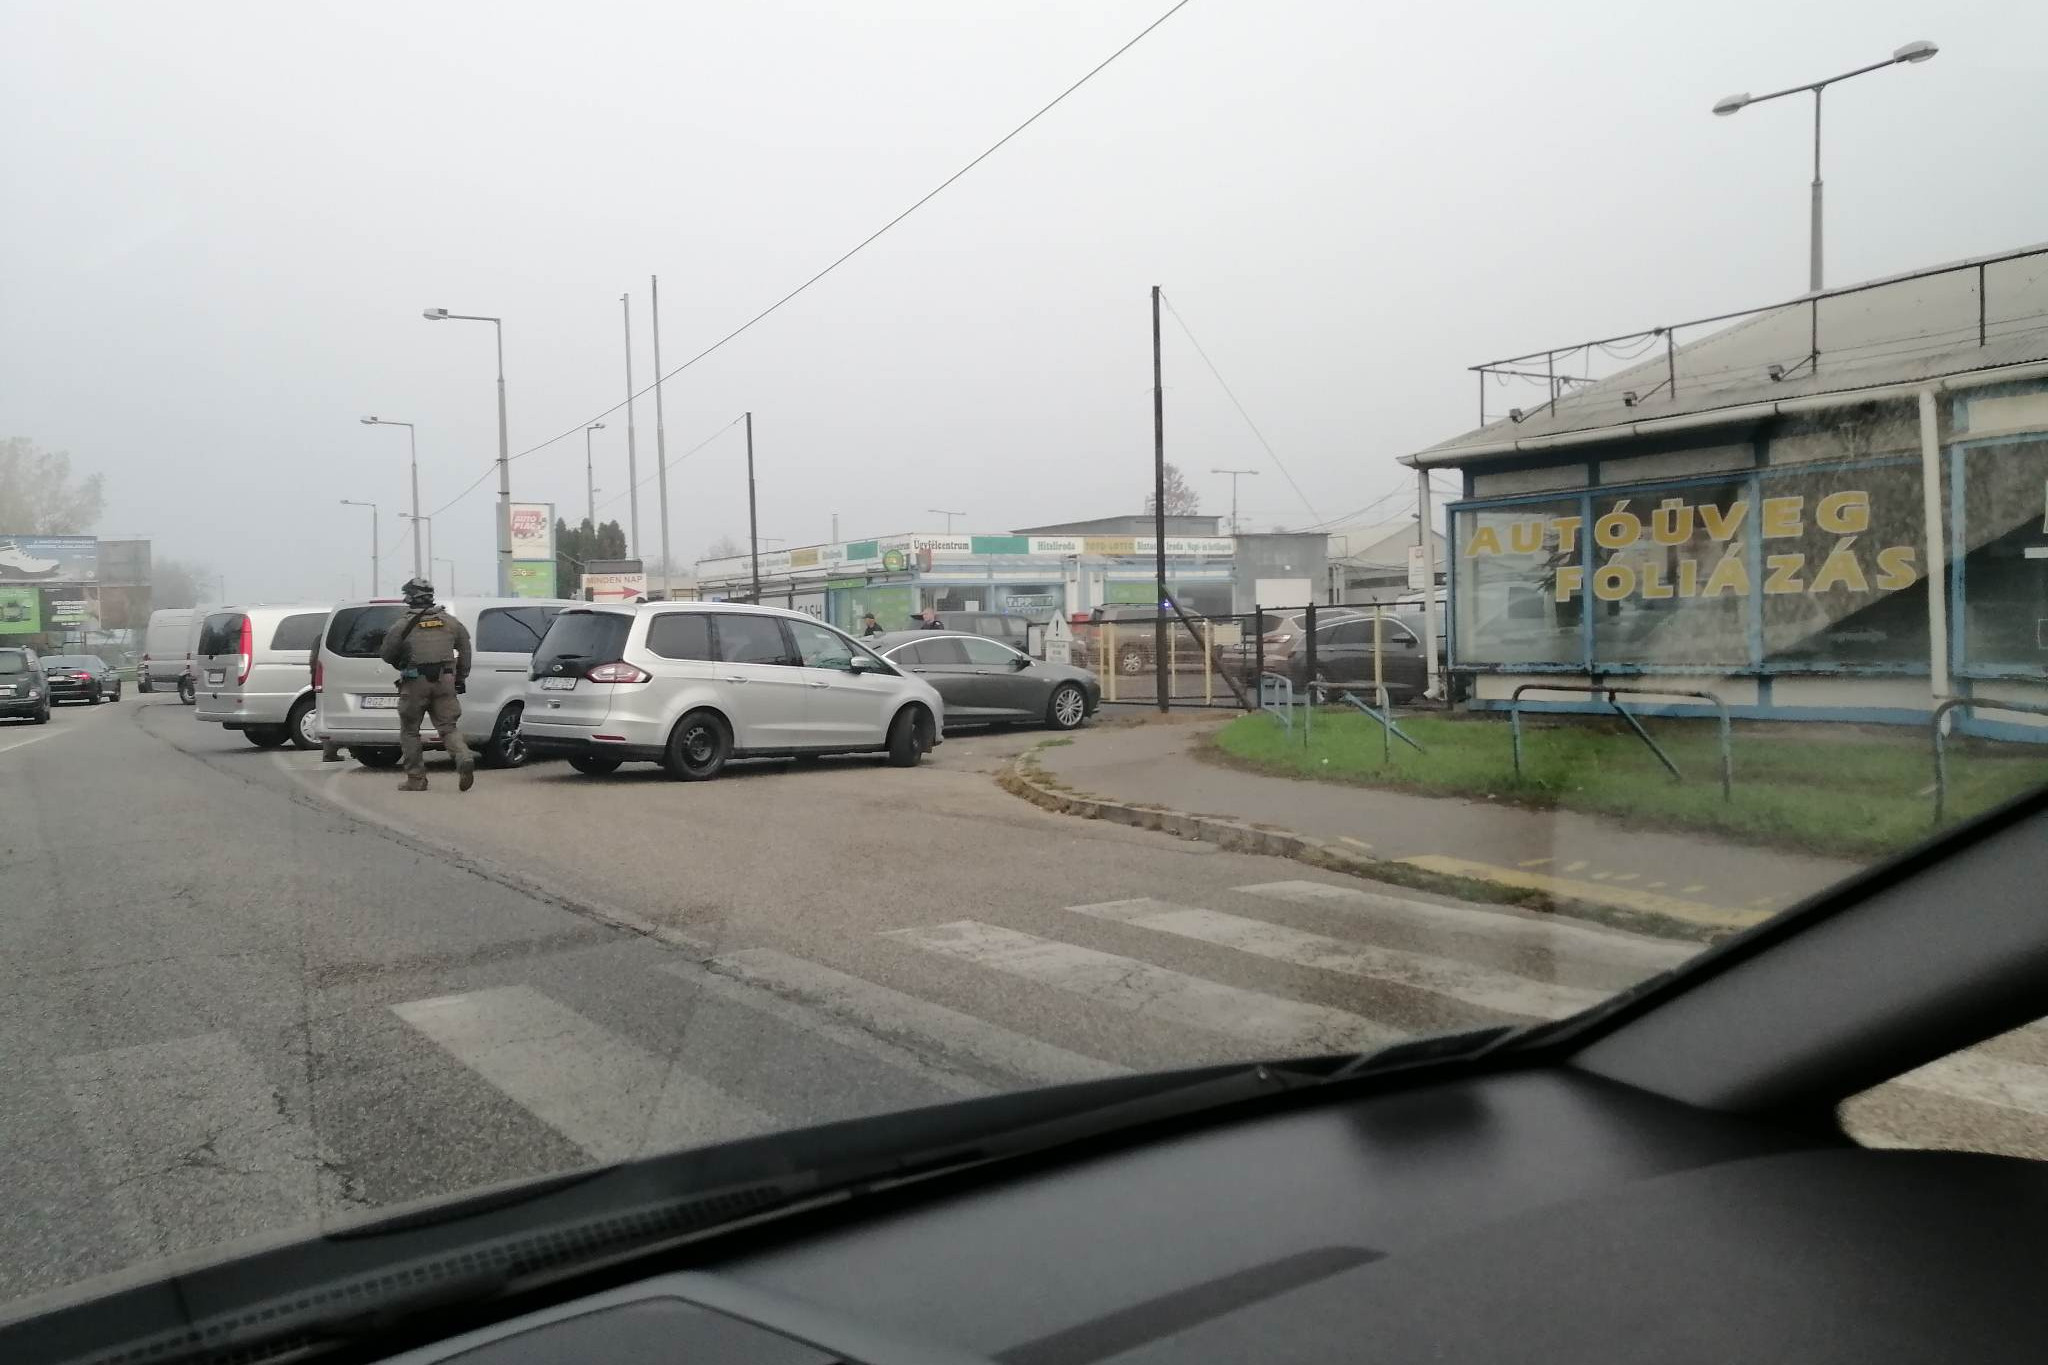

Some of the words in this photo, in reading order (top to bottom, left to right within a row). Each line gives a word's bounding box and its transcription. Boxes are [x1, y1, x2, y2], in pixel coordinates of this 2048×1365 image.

[1464, 490, 1871, 558] AUTÓÜVEG
[913, 538, 969, 551] Ügyfélcentrum
[585, 576, 622, 585] MINDEN
[625, 576, 643, 584] NAP
[1555, 536, 1918, 602] FÓLIÁZÁS
